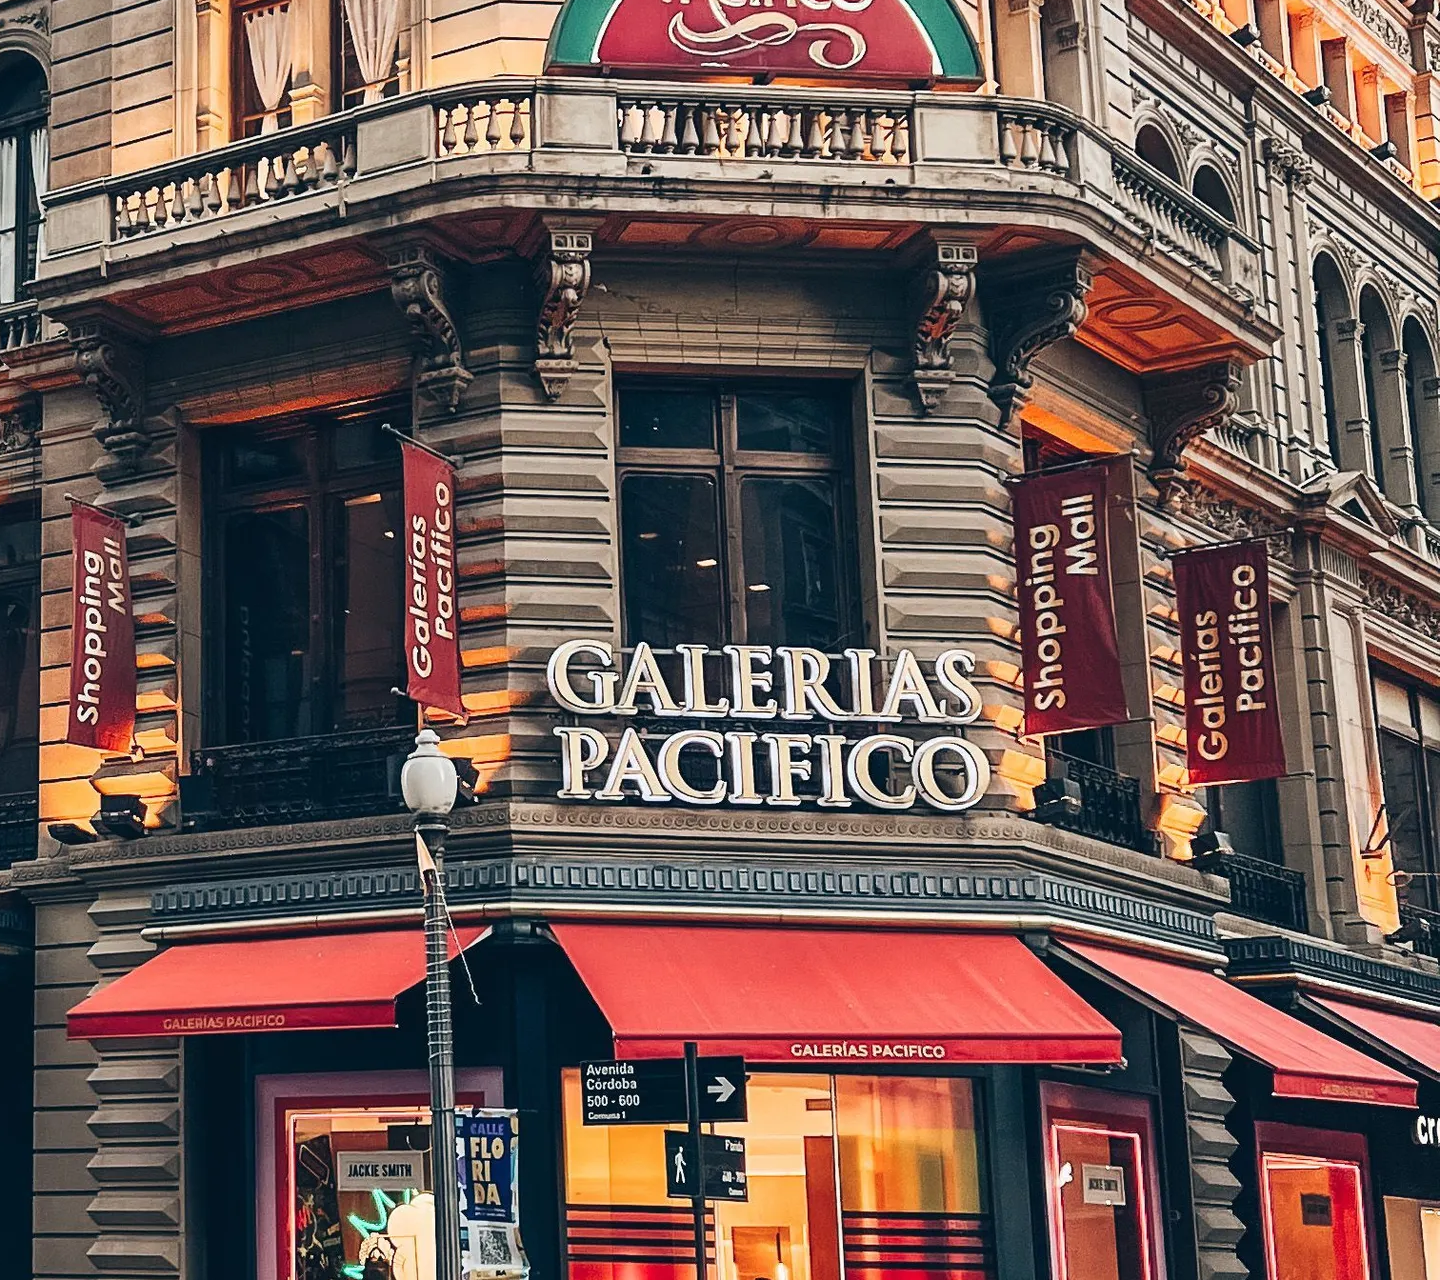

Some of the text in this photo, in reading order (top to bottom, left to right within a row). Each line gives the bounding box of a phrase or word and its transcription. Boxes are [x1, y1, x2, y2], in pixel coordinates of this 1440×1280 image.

[1061, 494, 1098, 575] Mall
[103, 537, 127, 615] Mall
[408, 514, 433, 678] Galerías
[1025, 524, 1068, 711] Shopping
[76, 550, 107, 726] Shopping
[546, 638, 983, 724] GALERIAS
[1190, 610, 1229, 761] Galerías
[552, 726, 992, 811] PACIFICO
[226, 1014, 286, 1027] PACIFICO
[790, 1040, 946, 1059] GALERÍAS PACIFICO
[586, 1063, 635, 1076] Avenida
[586, 1077, 637, 1091] Córdoba
[587, 1095, 609, 1107] 500
[618, 1094, 641, 1107] 600
[621, 1110, 627, 1119] 1
[469, 1122, 505, 1136] CALLE
[1416, 1115, 1440, 1145] cr
[469, 1136, 505, 1160] FLO
[348, 1163, 412, 1177] JACKIE SMITH
[471, 1159, 491, 1182] RI
[473, 1182, 502, 1206] DA
